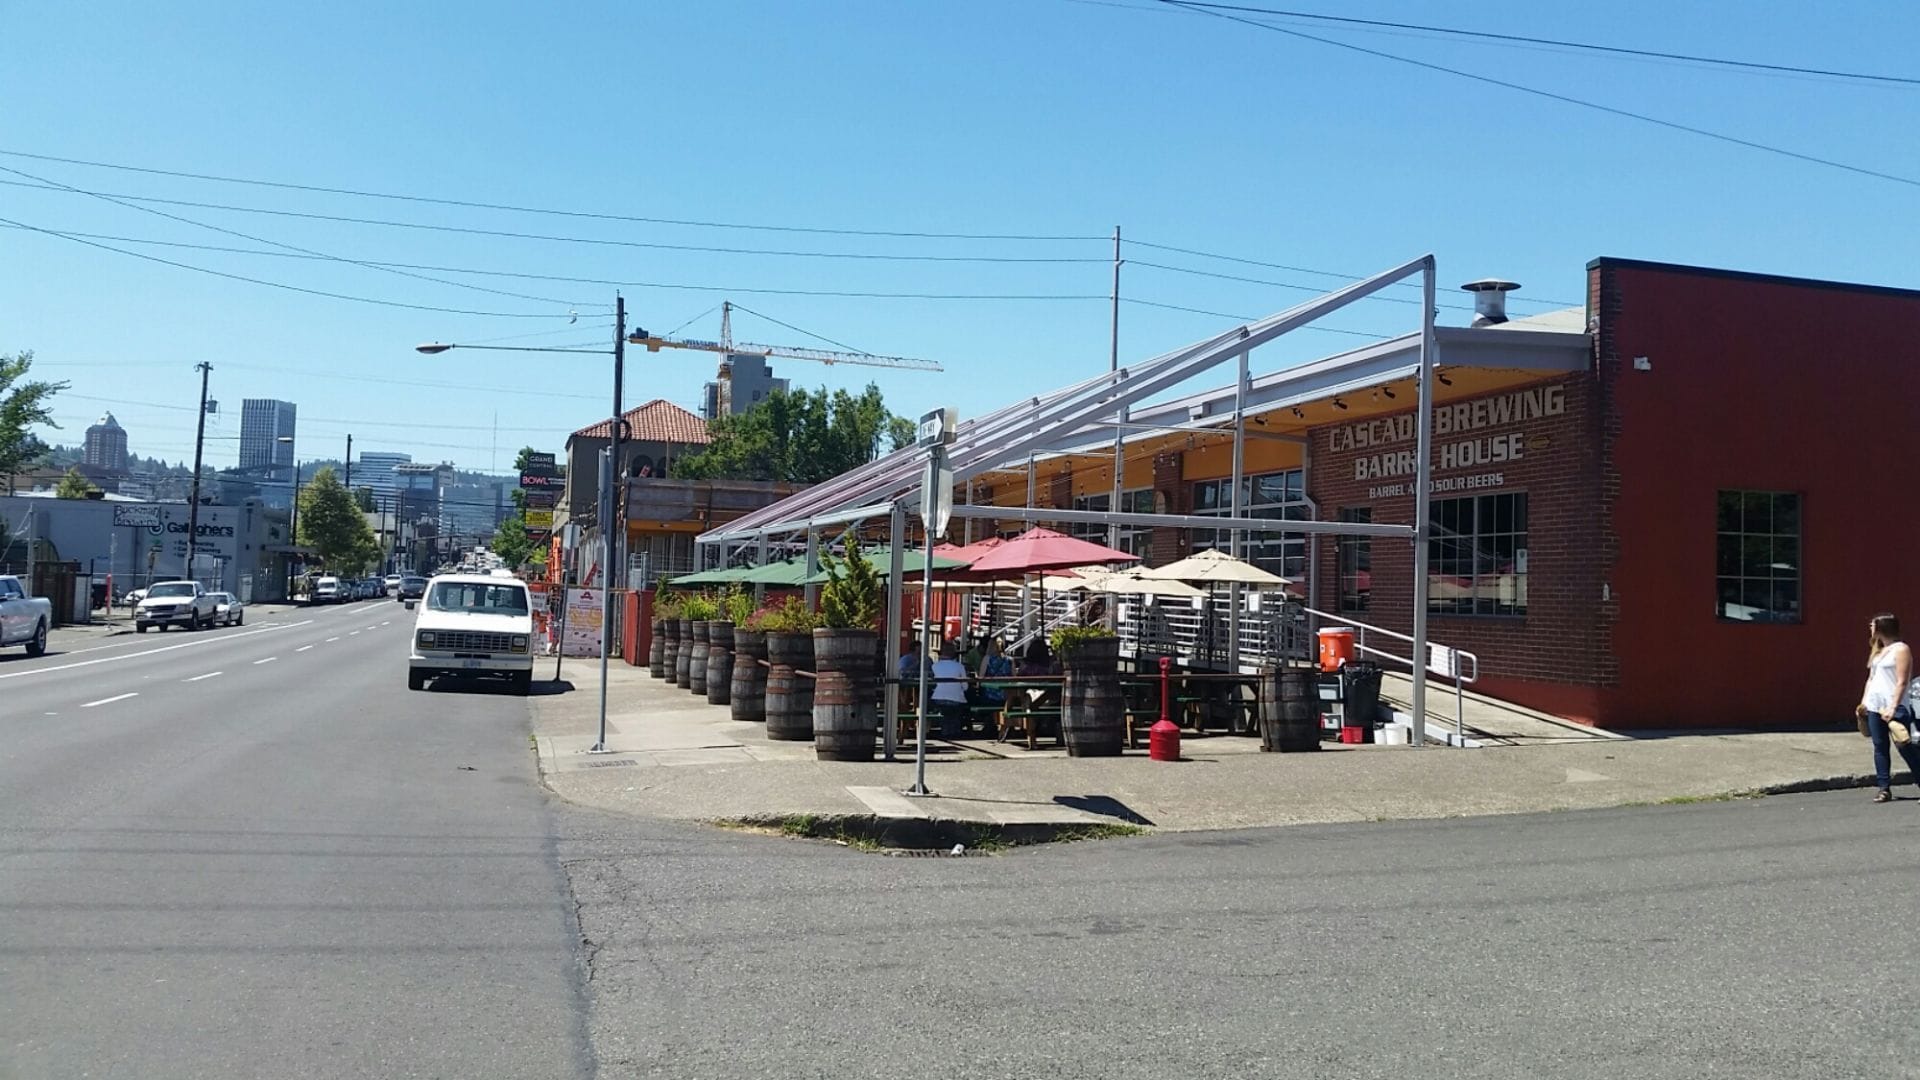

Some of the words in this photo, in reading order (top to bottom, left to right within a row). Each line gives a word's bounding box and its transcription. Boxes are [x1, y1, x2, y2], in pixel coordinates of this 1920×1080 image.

[1435, 384, 1565, 435] BREWING
[1440, 432, 1524, 470] HOUSE
[522, 475, 549, 486] BOWL
[1369, 485, 1407, 499] BARREL
[1436, 476, 1465, 492] SOUR
[1467, 472, 1504, 489] BEERS
[167, 522, 234, 537] Gallghers
